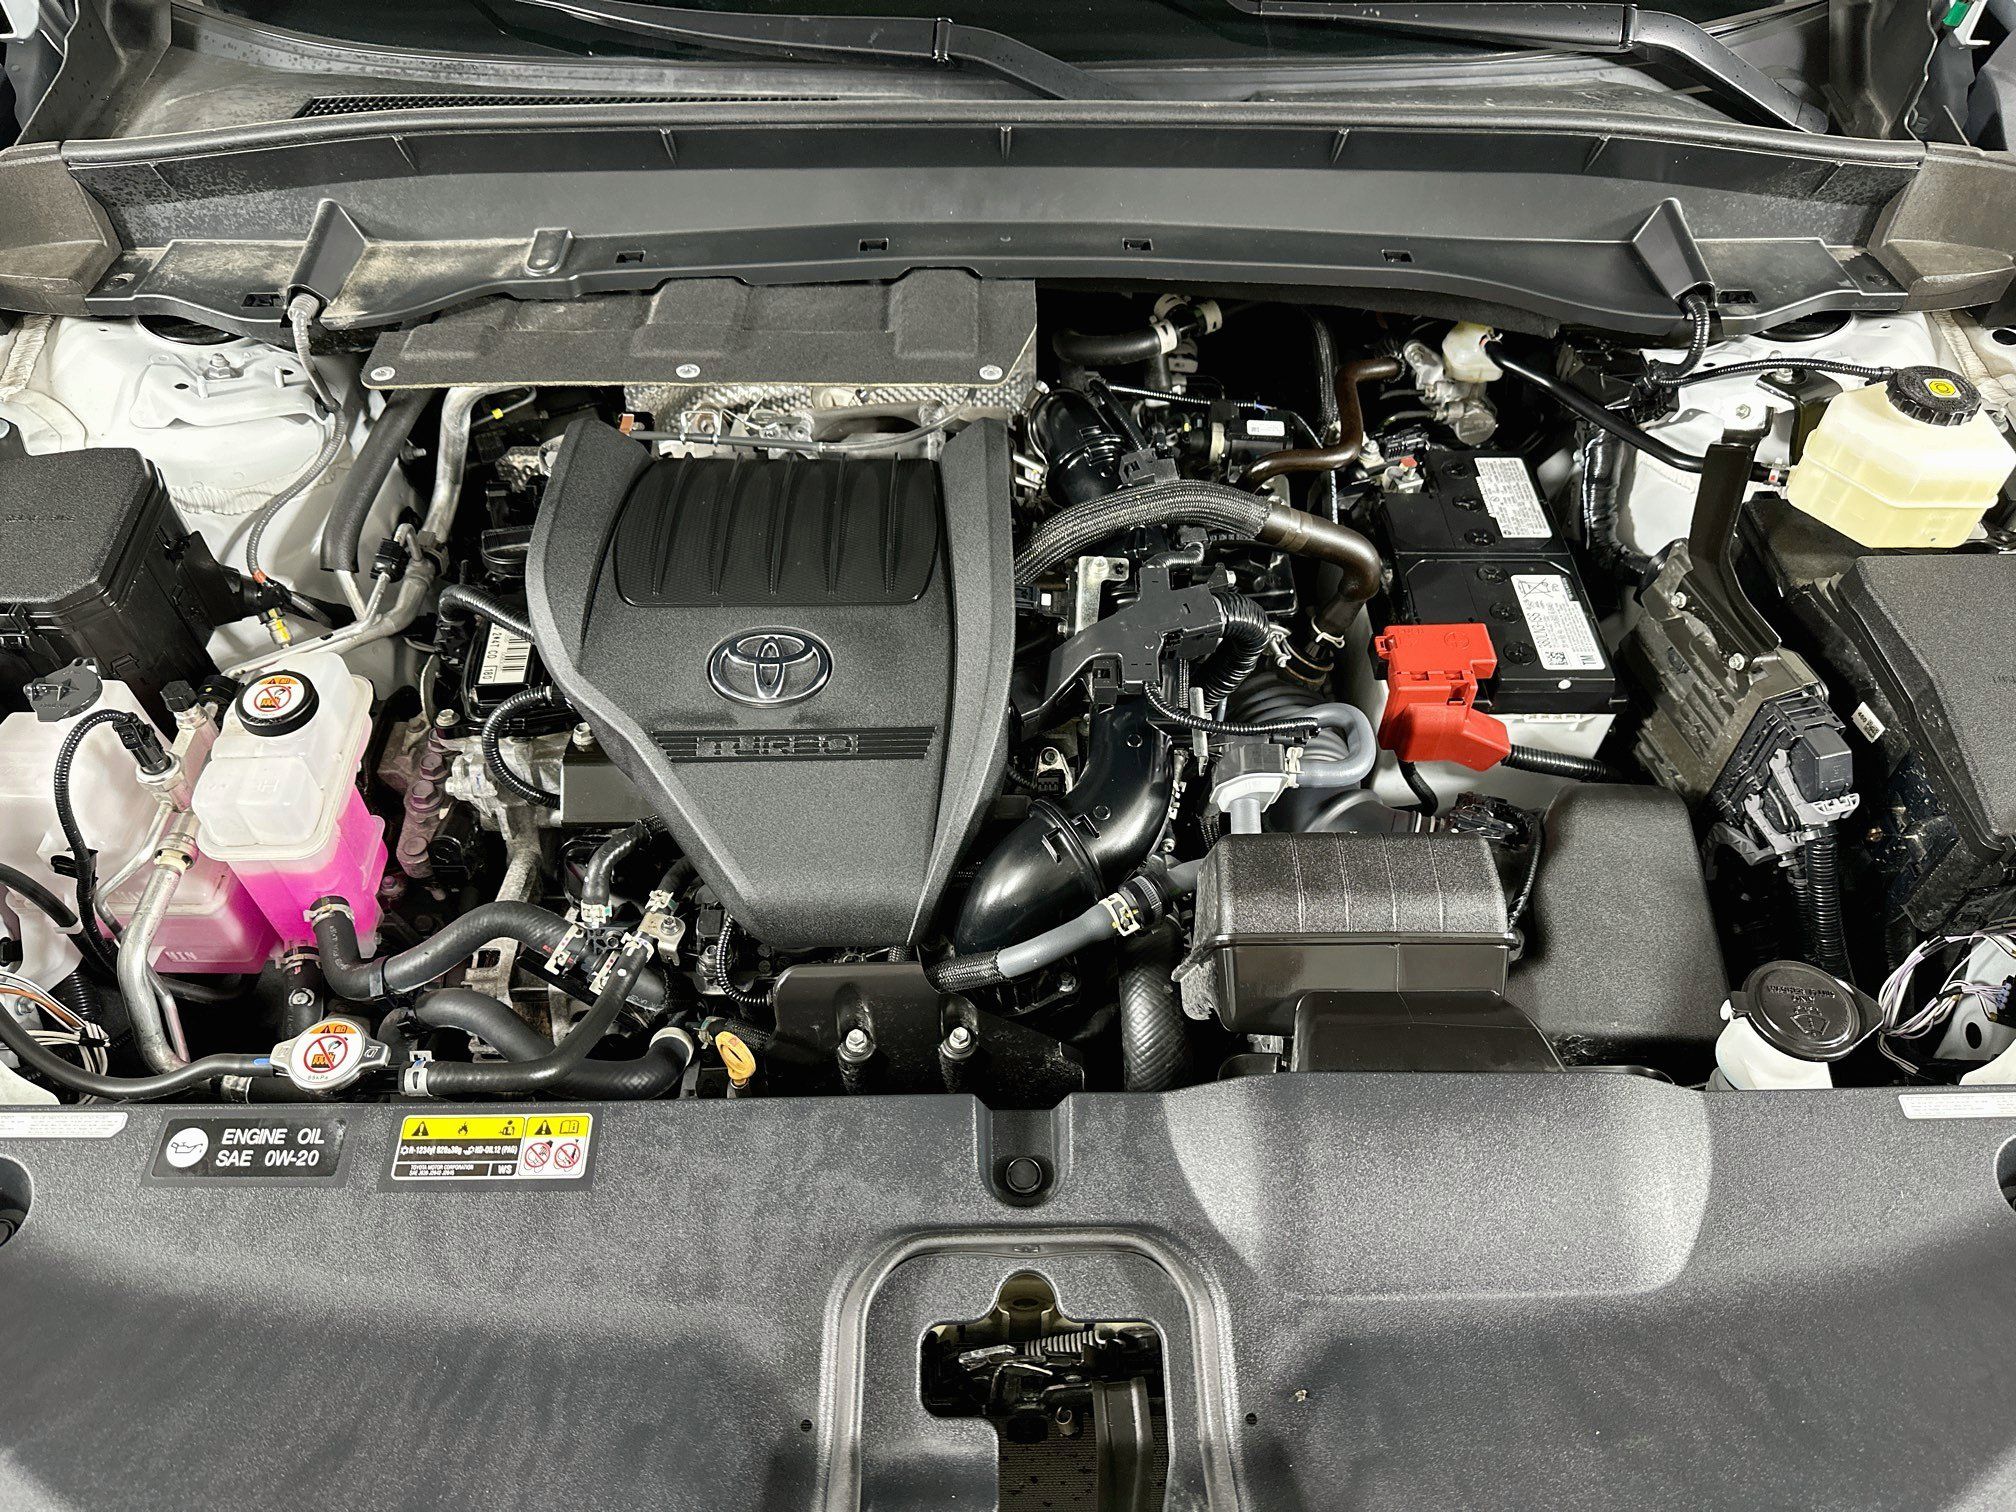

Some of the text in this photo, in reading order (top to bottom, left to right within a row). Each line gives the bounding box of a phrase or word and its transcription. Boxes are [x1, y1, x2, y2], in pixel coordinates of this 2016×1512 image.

[221, 1128, 325, 1145] ENGINE OIL
[215, 1149, 320, 1167] SAE 0W-20
[497, 1164, 513, 1175] WS
